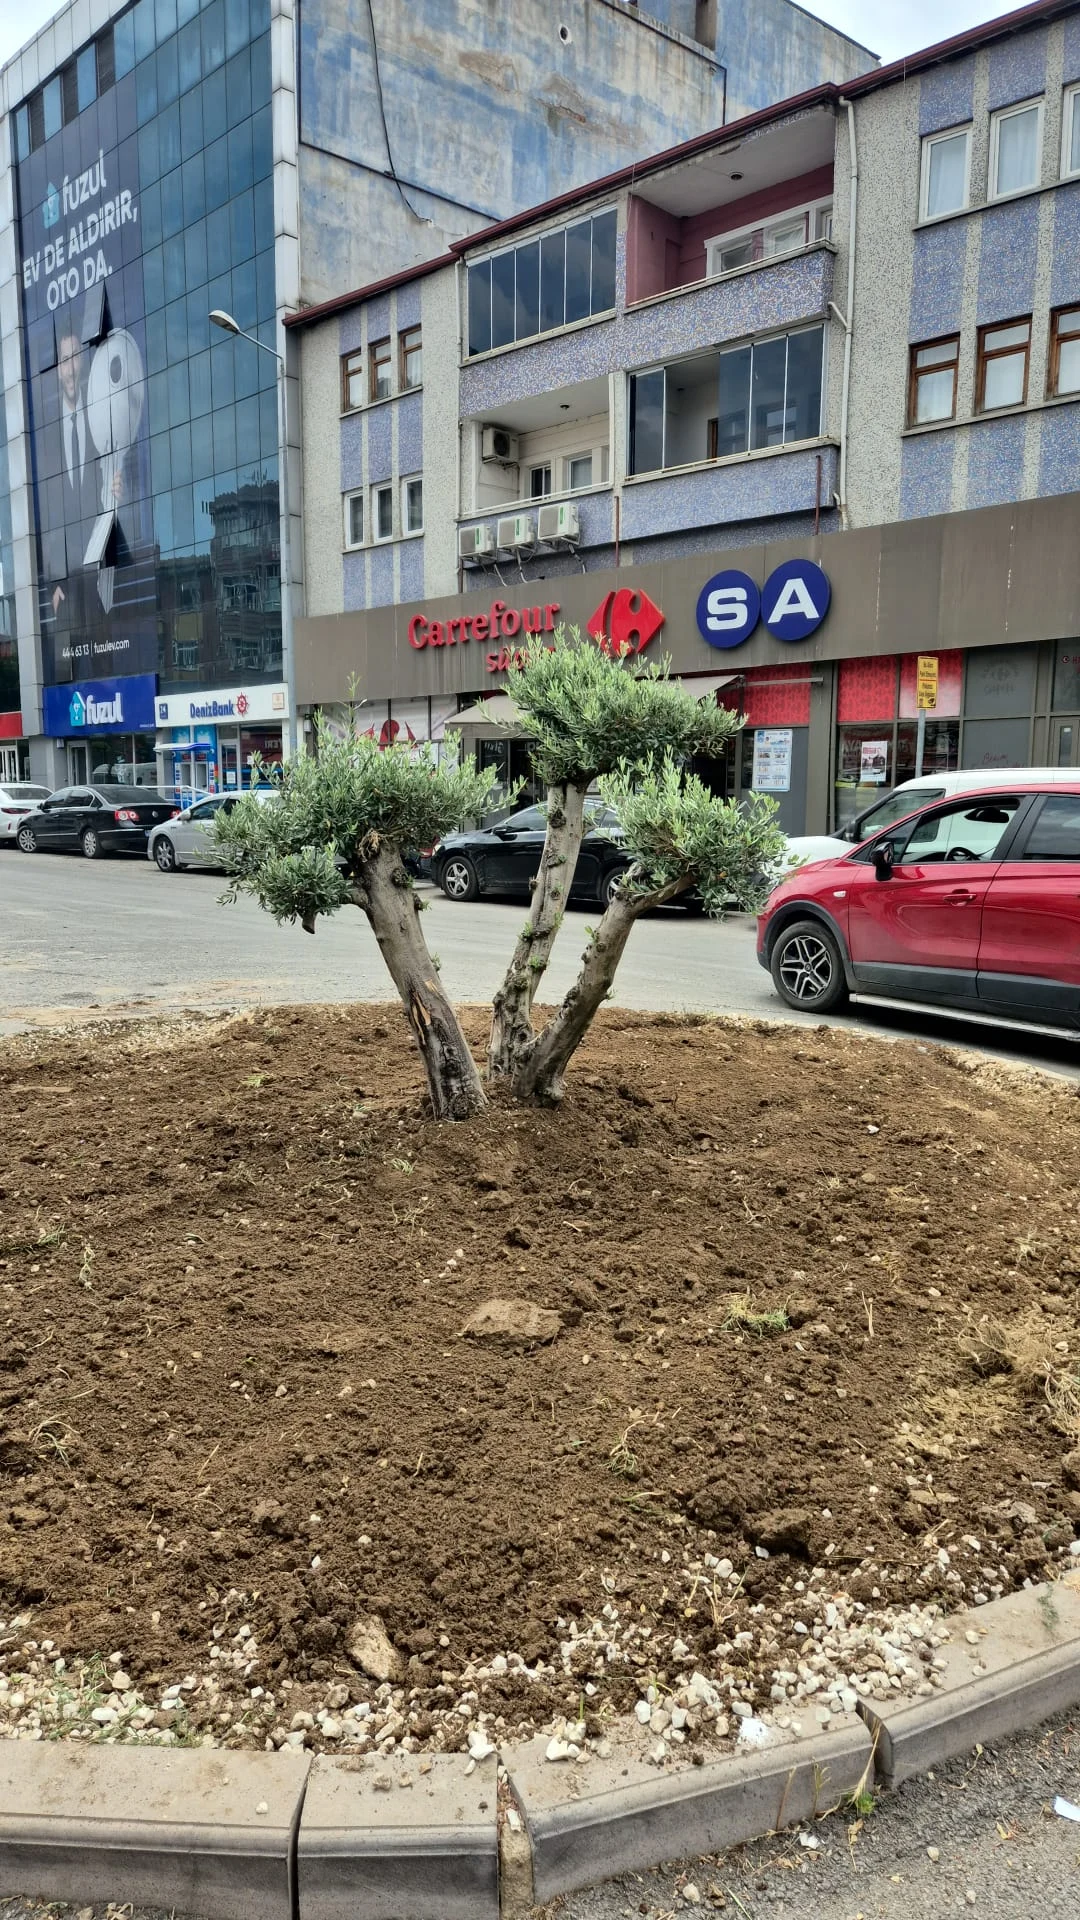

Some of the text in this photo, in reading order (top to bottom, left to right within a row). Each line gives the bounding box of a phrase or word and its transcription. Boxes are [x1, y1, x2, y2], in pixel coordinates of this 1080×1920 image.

[62, 149, 107, 216] fuzul
[23, 189, 138, 289] EV DE ALDIRIR,
[46, 249, 113, 311] OTO DA.
[407, 600, 561, 649] Carrefour
[75, 645, 82, 657] 63
[83, 643, 90, 656] 13
[86, 692, 124, 725] fuzul
[189, 700, 235, 718] DenizBank
